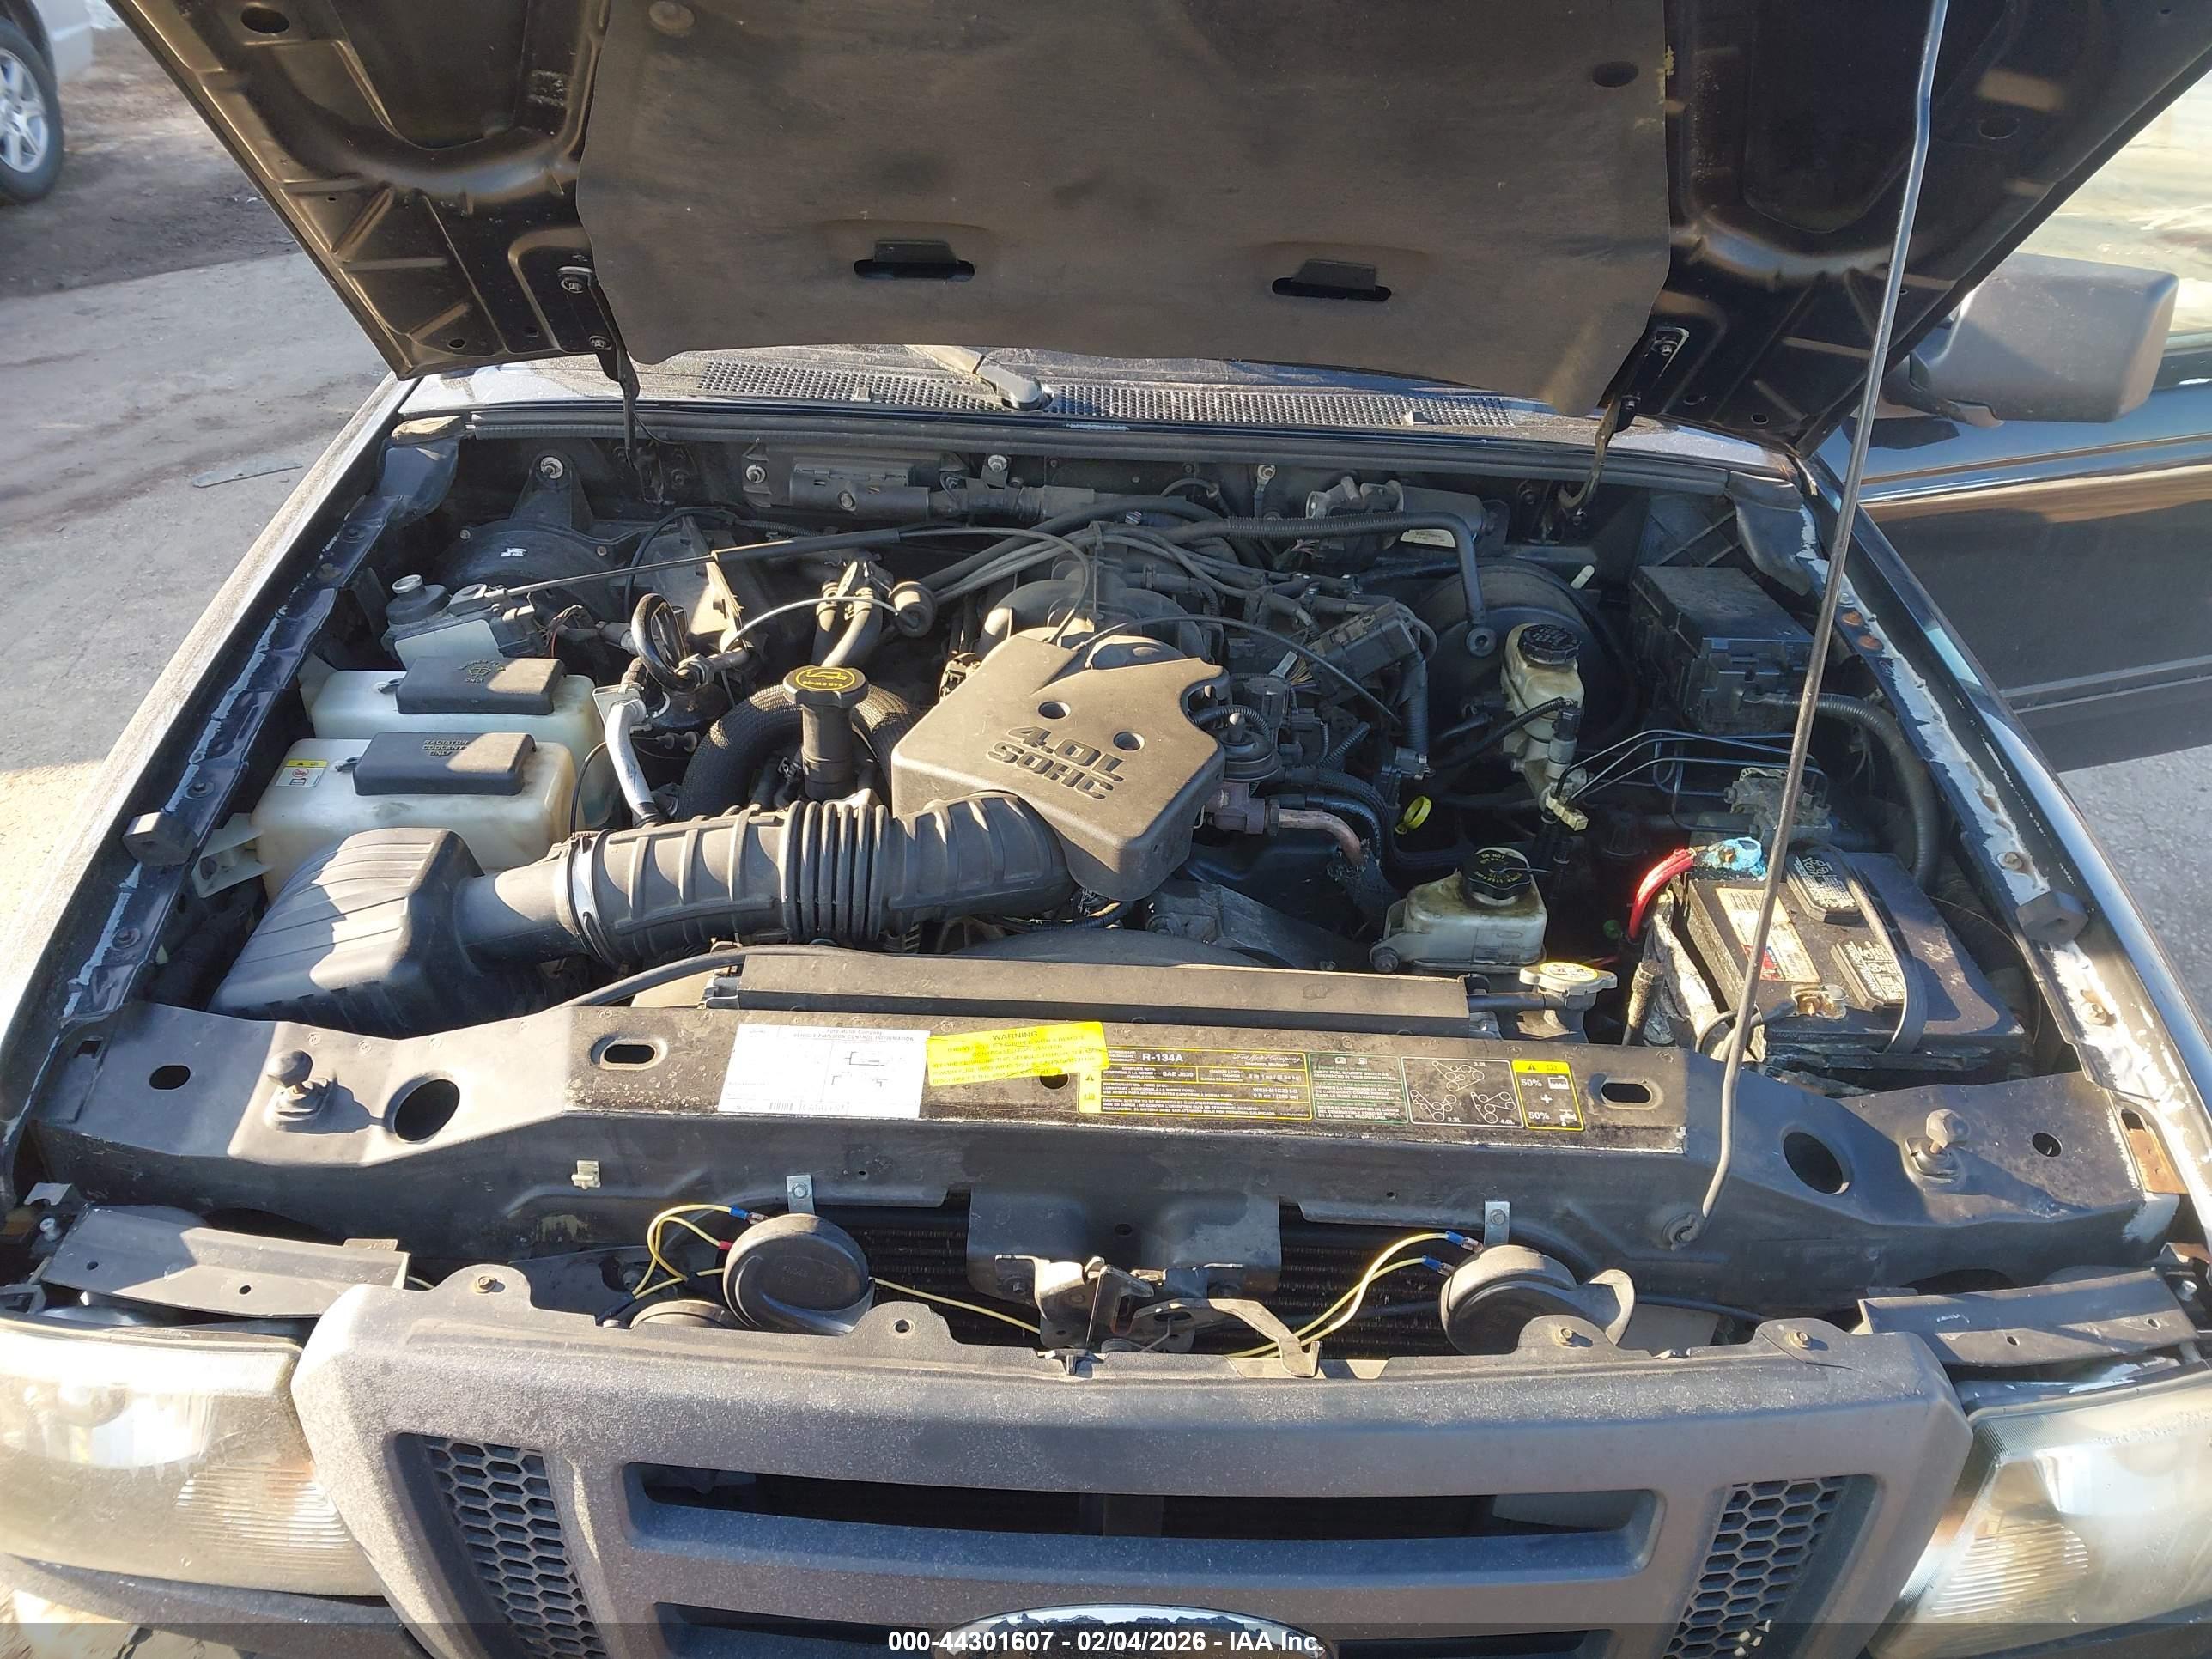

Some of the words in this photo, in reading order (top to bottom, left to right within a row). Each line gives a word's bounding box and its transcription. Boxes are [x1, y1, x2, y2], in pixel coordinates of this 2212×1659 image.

[1007, 726, 1126, 781] 4.0L
[986, 742, 1114, 799] SOHC
[992, 1031, 1037, 1040] WARNING
[1142, 1053, 1183, 1062] R-134A
